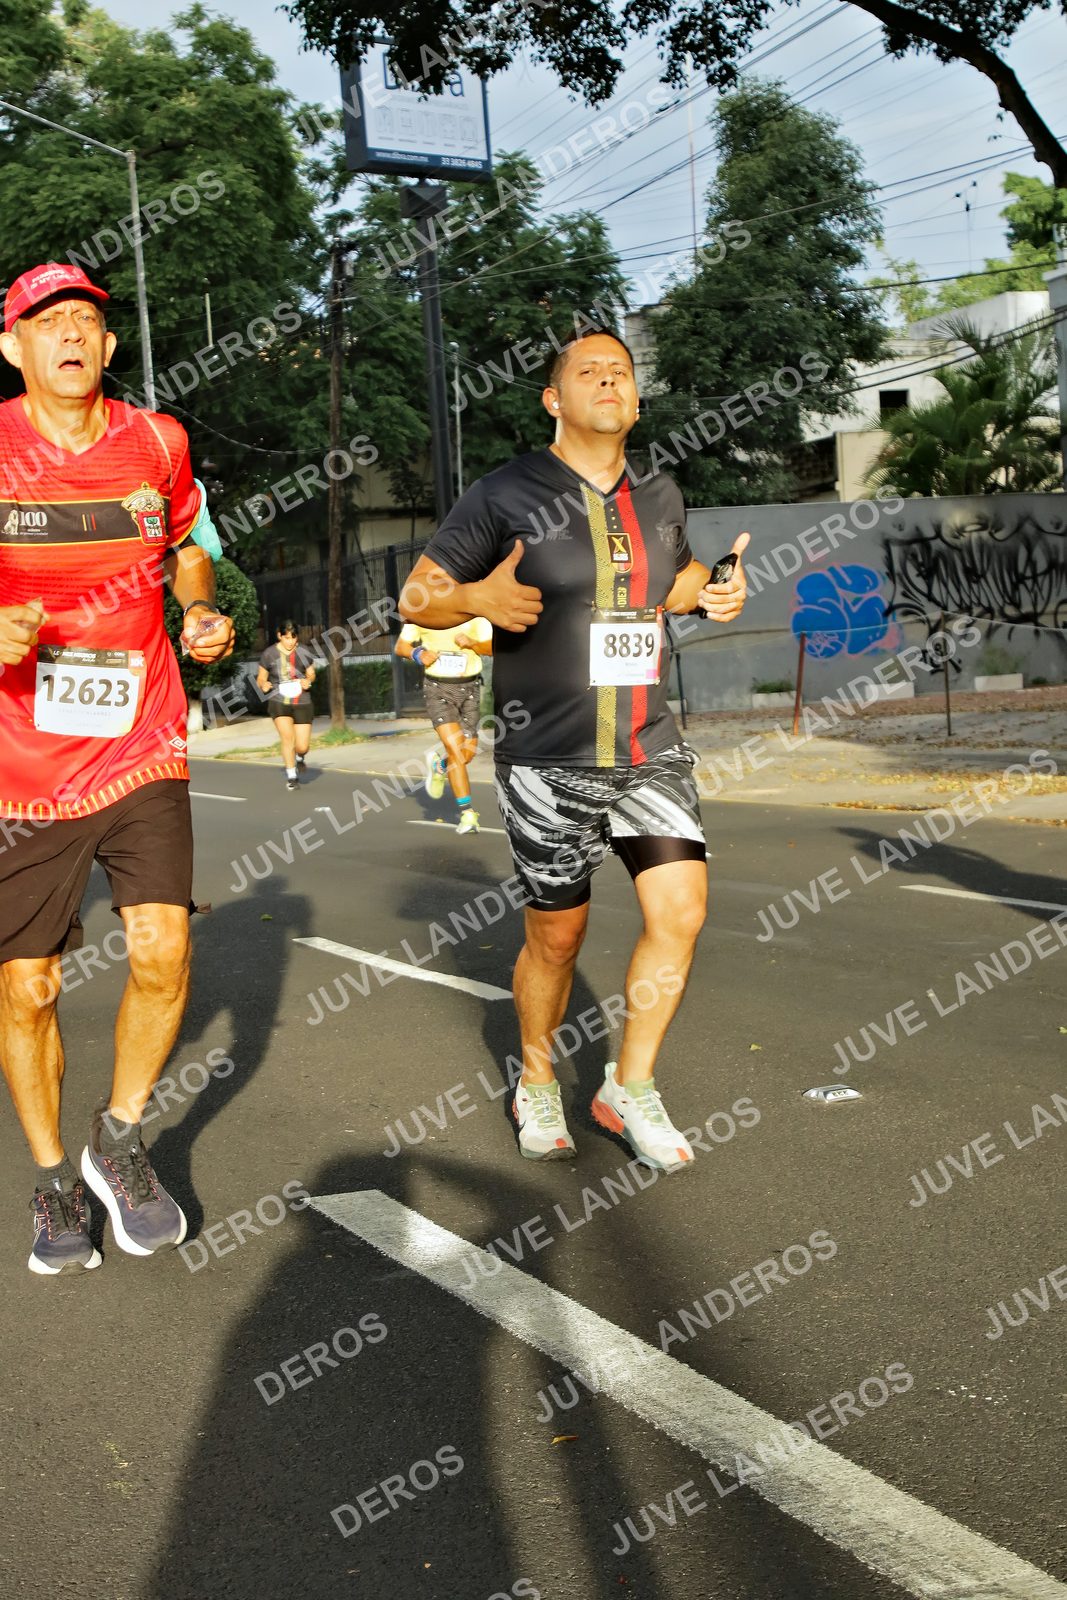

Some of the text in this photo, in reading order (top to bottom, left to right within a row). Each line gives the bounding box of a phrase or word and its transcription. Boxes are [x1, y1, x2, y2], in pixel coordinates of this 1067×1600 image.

[19, 511, 48, 527] 100
[604, 632, 655, 658] 8839
[42, 674, 130, 708] 12623
